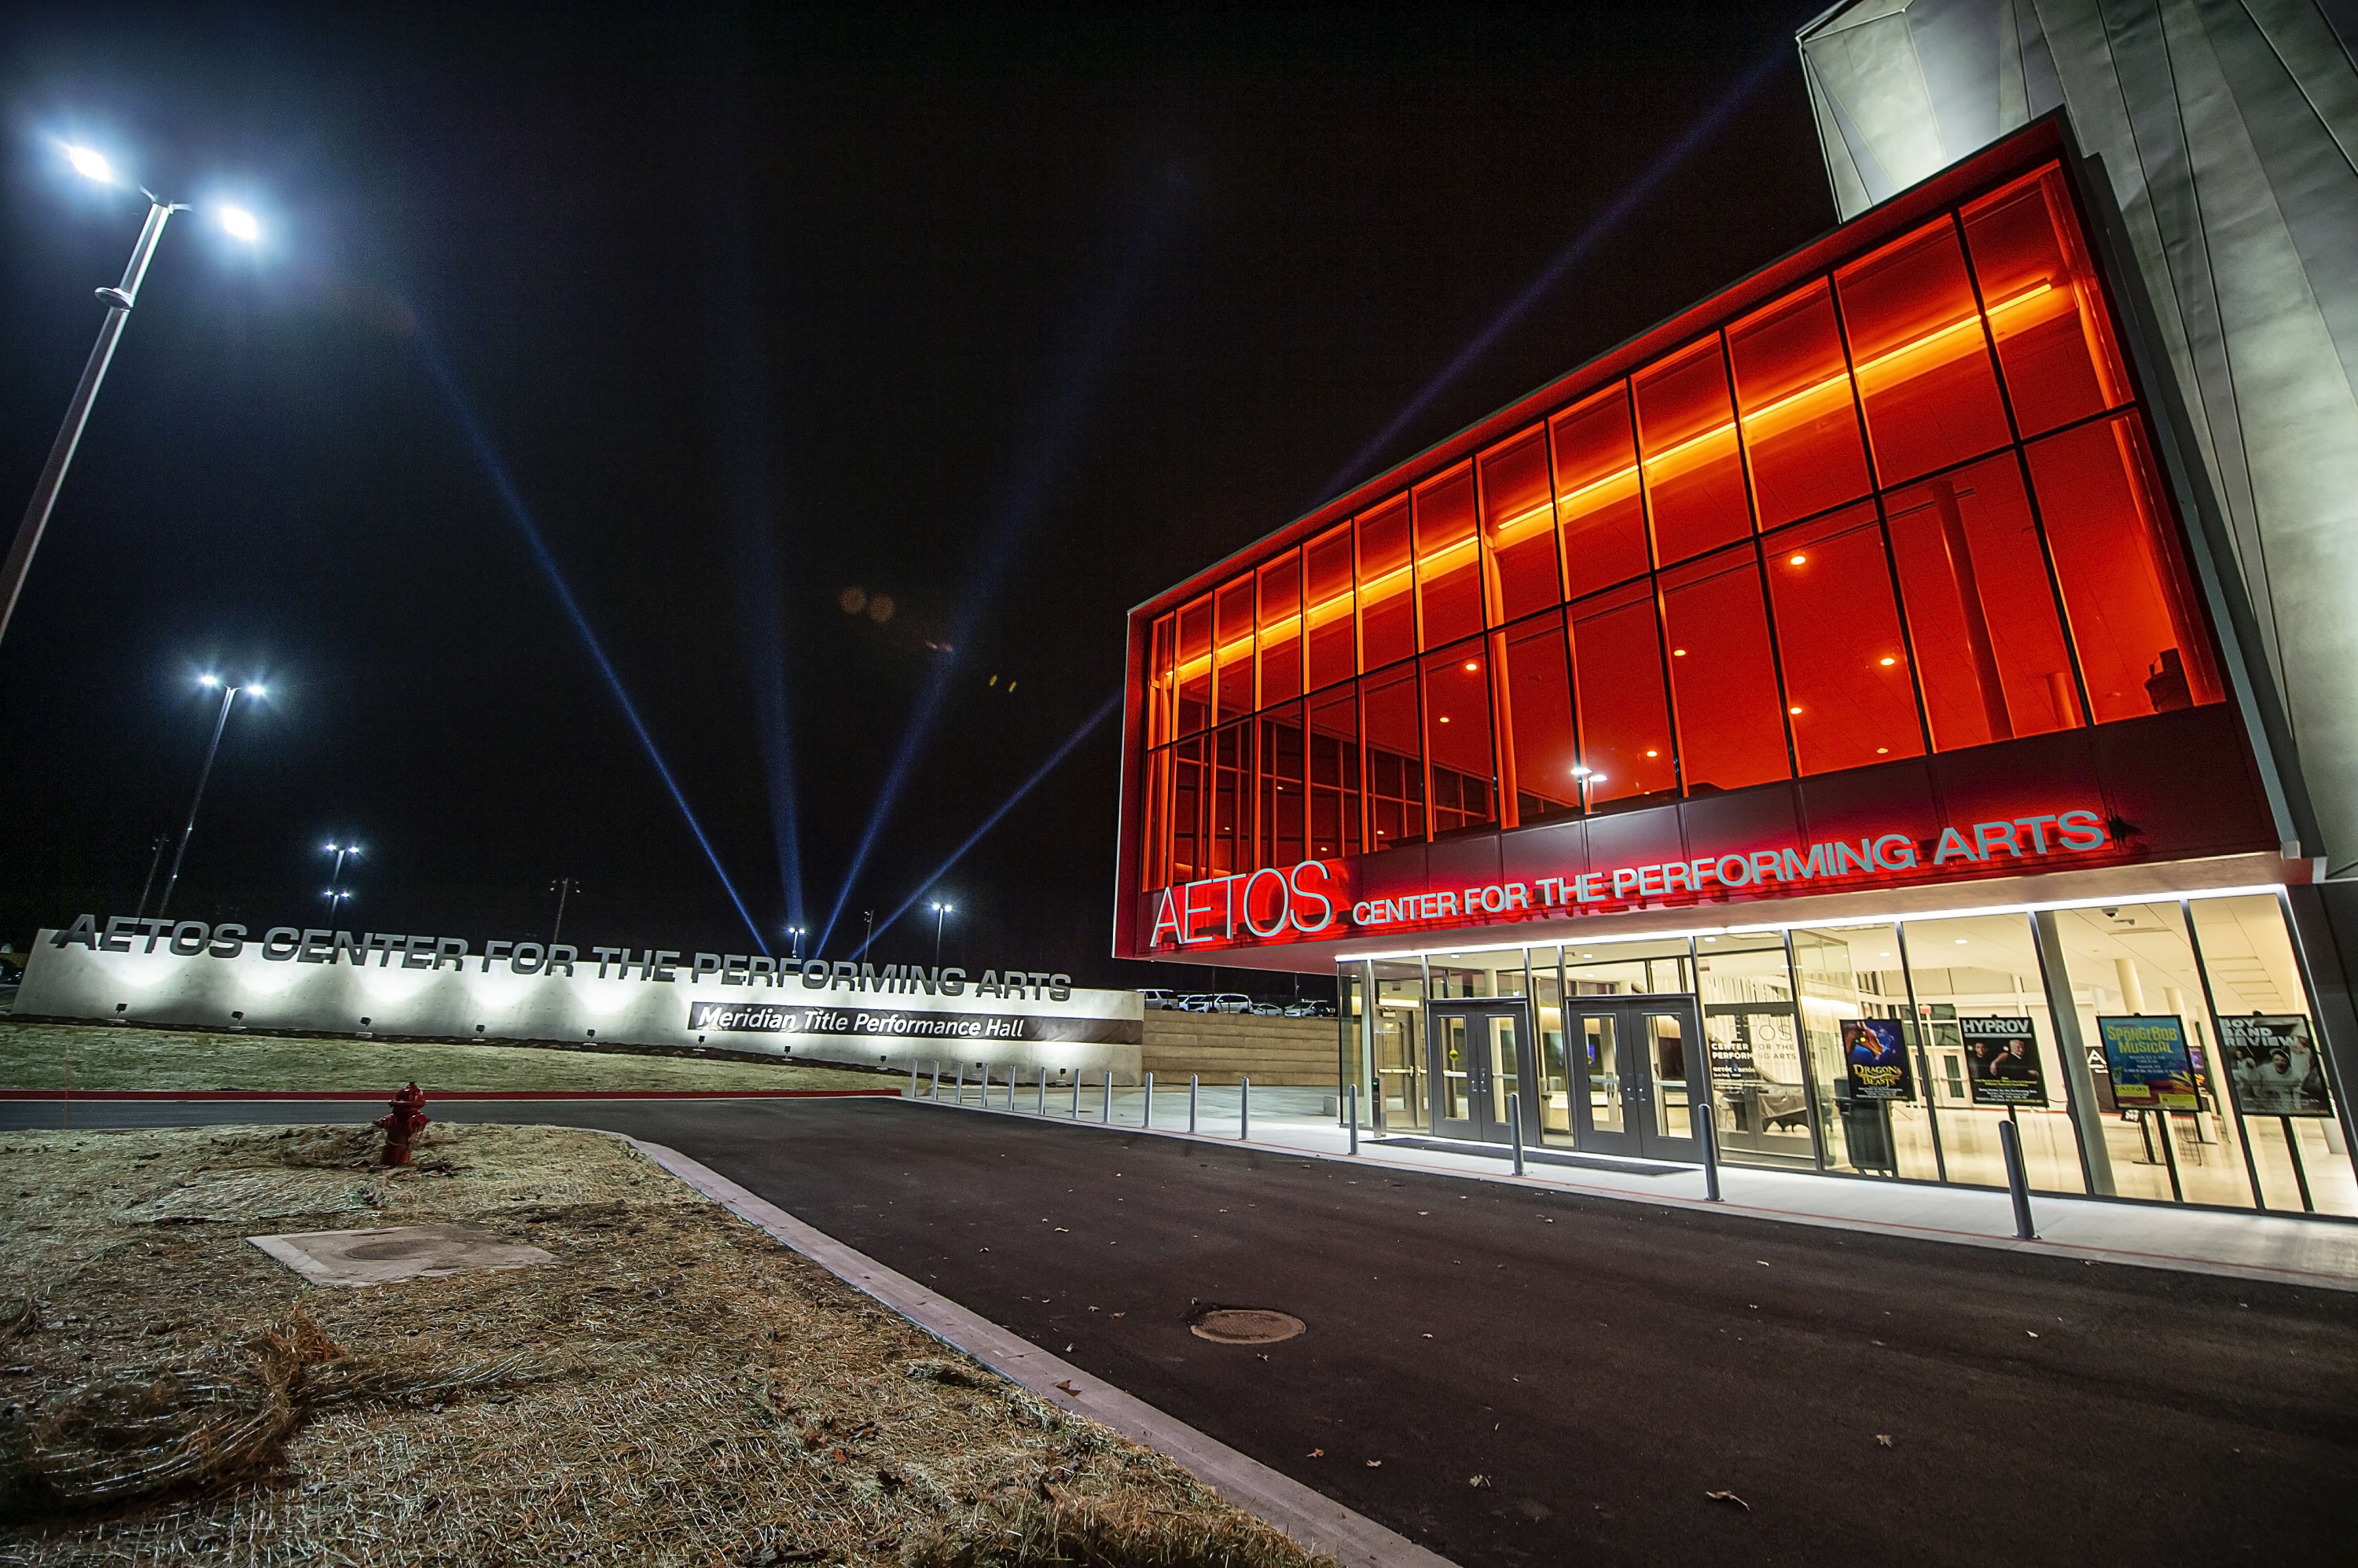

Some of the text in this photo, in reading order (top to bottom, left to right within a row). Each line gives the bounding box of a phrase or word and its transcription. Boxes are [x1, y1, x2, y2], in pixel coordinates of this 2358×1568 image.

[1149, 810, 2106, 948] AETOS CENTER FOR THE PERFORMING ARTS
[56, 913, 1072, 1002] AETOS CENTER FOR THE PERFORMING ARTS
[697, 1006, 1024, 1038] Meridian Title Performance Hall
[1962, 1019, 2029, 1033] HYPROV
[2222, 1027, 2272, 1037] BAND
[2224, 1036, 2298, 1046] REVIEW
